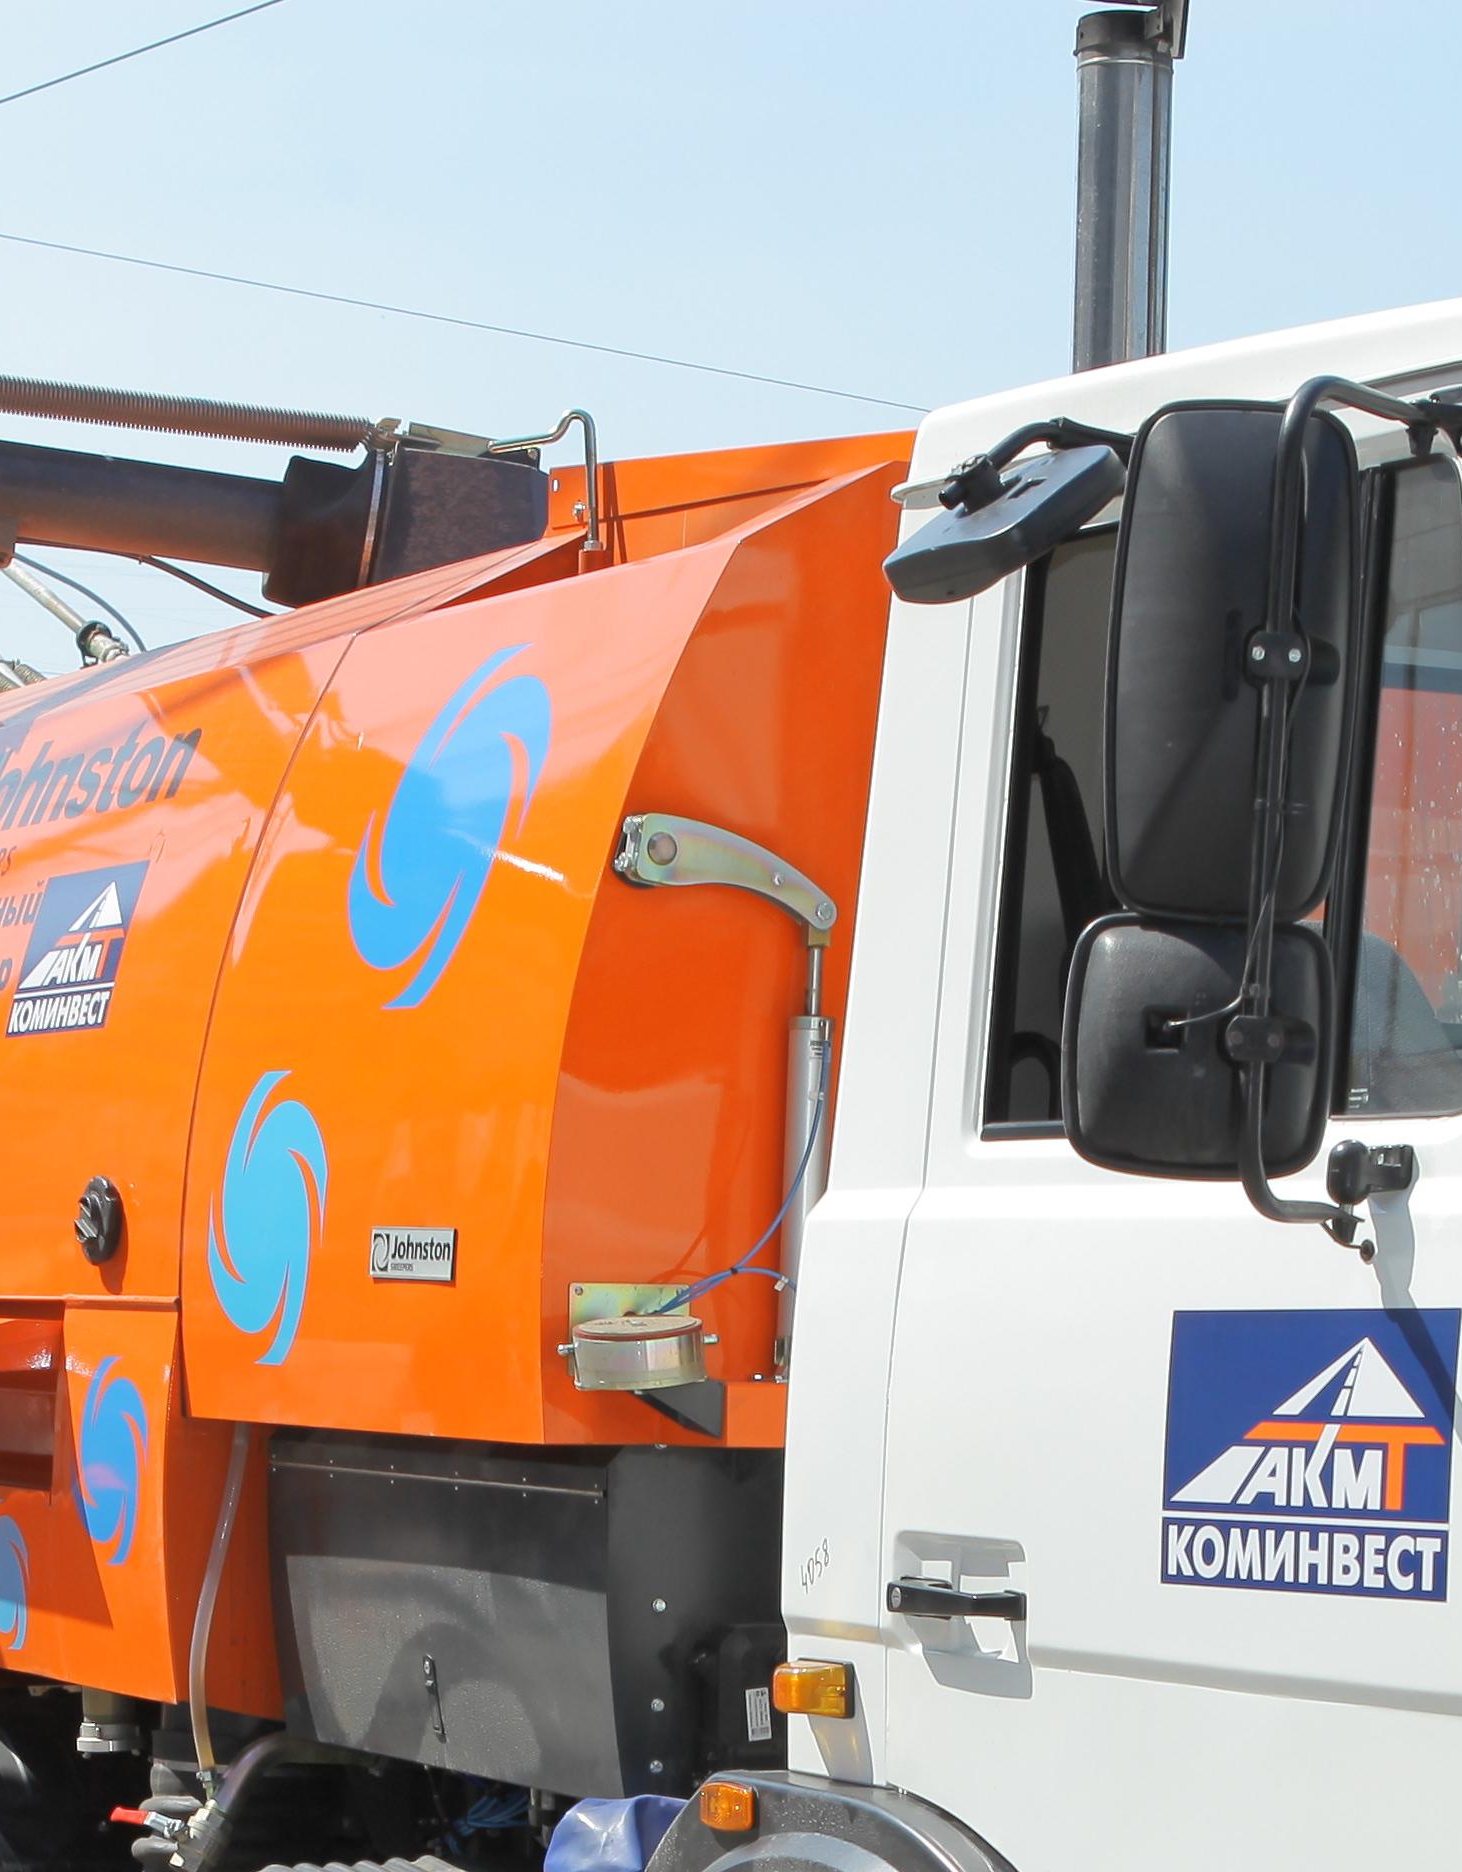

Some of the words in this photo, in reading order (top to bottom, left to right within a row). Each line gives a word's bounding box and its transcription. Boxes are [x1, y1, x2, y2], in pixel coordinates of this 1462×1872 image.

[7, 990, 111, 1034] КОМИНВЕСТ
[391, 1234, 451, 1261] Johnston
[1236, 1421, 1446, 1511] АКМТ
[1166, 1523, 1442, 1592] КОМИНВЕСТ
